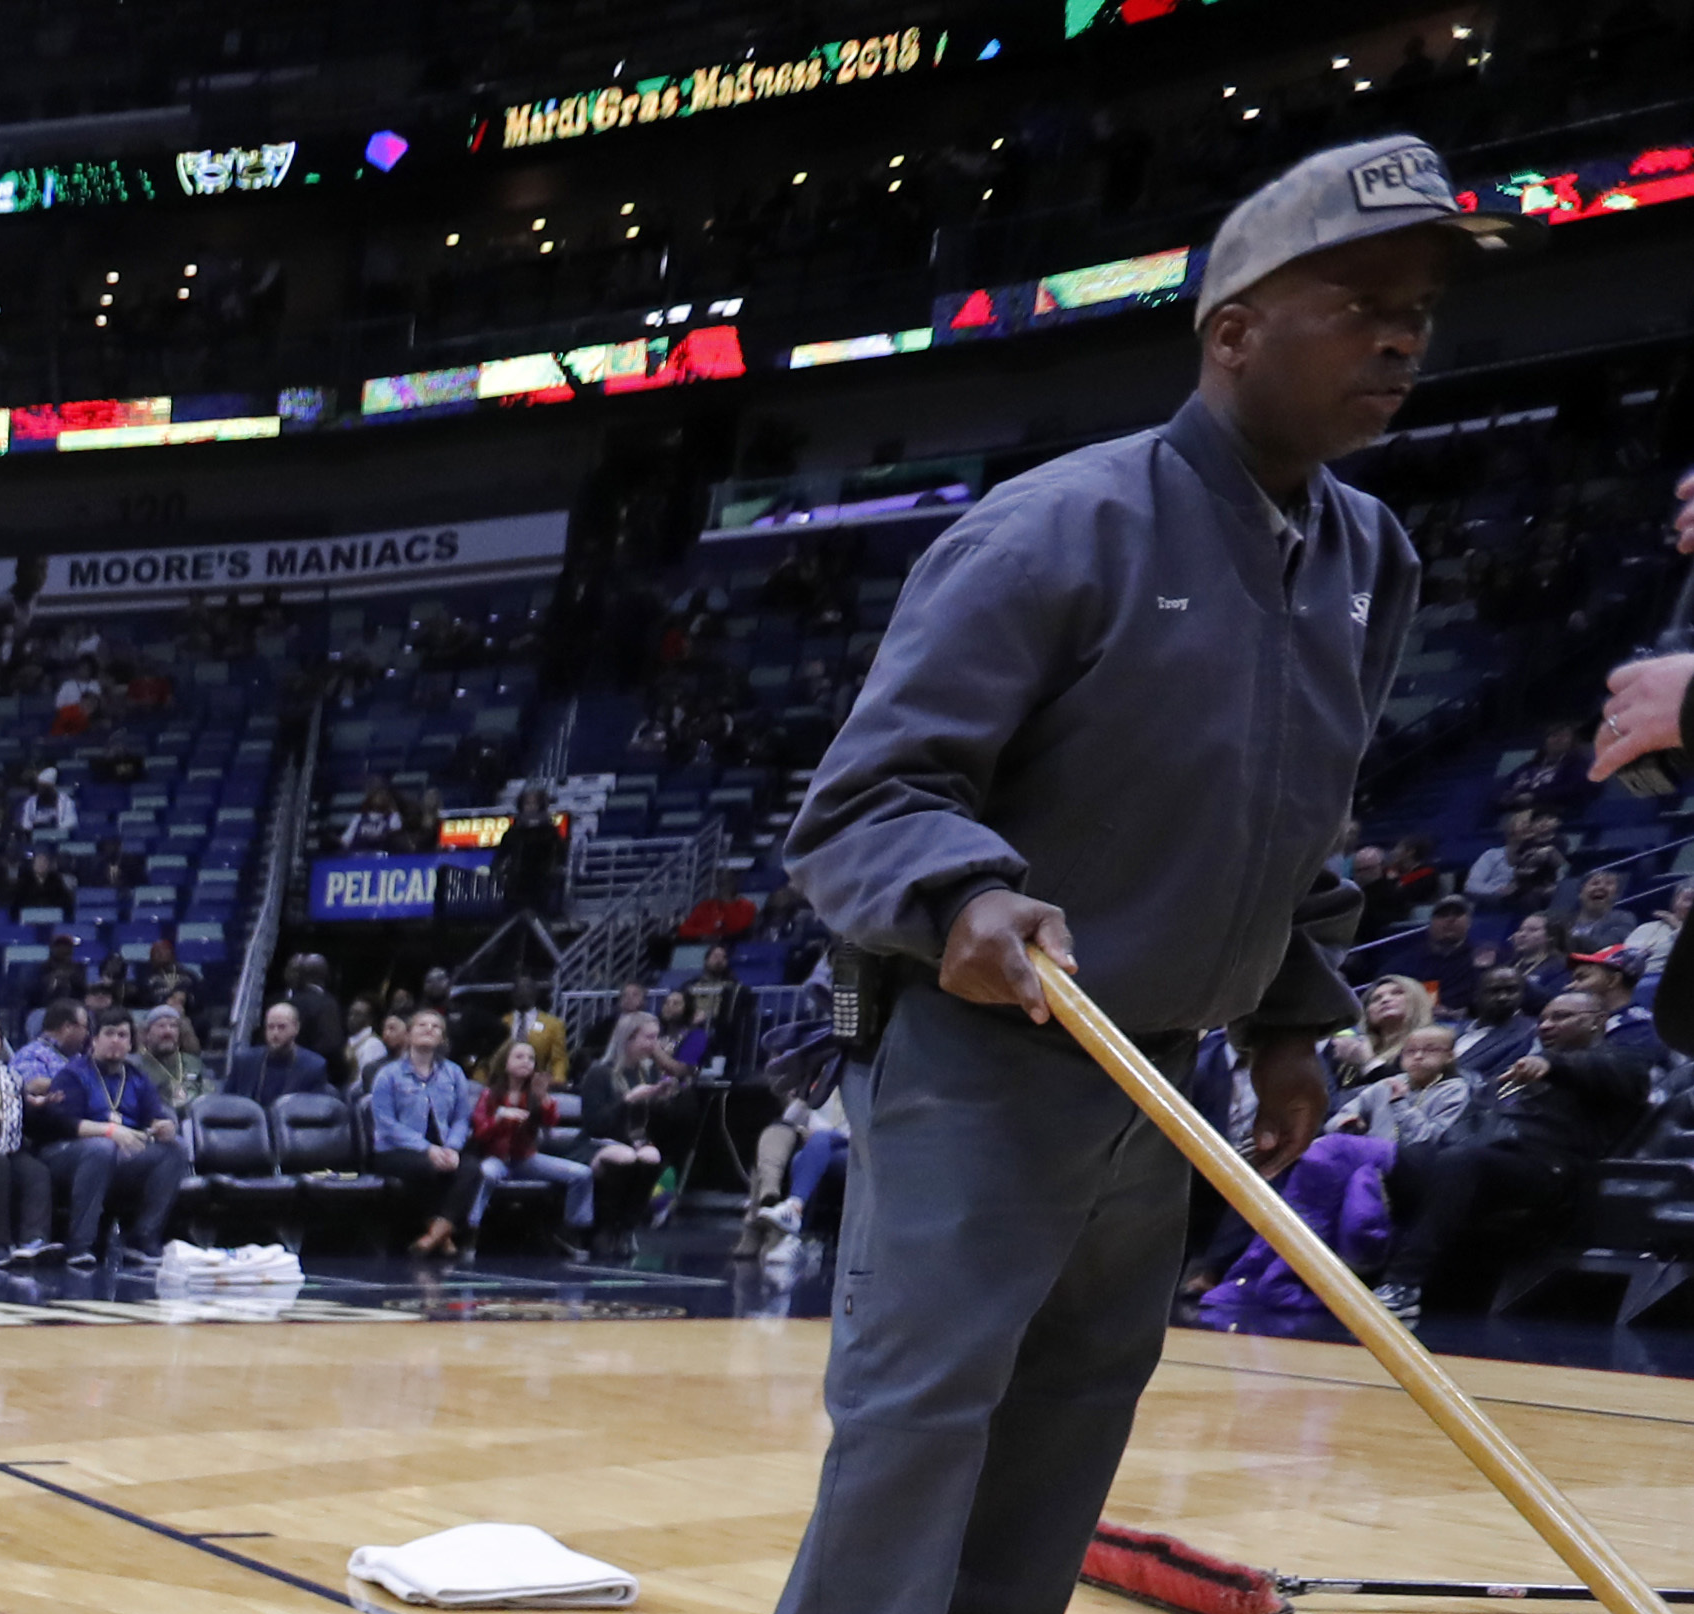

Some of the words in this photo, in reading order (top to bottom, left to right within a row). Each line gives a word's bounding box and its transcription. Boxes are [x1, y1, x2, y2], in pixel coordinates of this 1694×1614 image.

[502, 95, 587, 148] Mardi
[590, 87, 680, 136] Gras
[689, 62, 822, 111] Madness
[836, 27, 920, 84] 2018
[69, 550, 252, 587] MOORE'S
[265, 530, 460, 577] MANIACS
